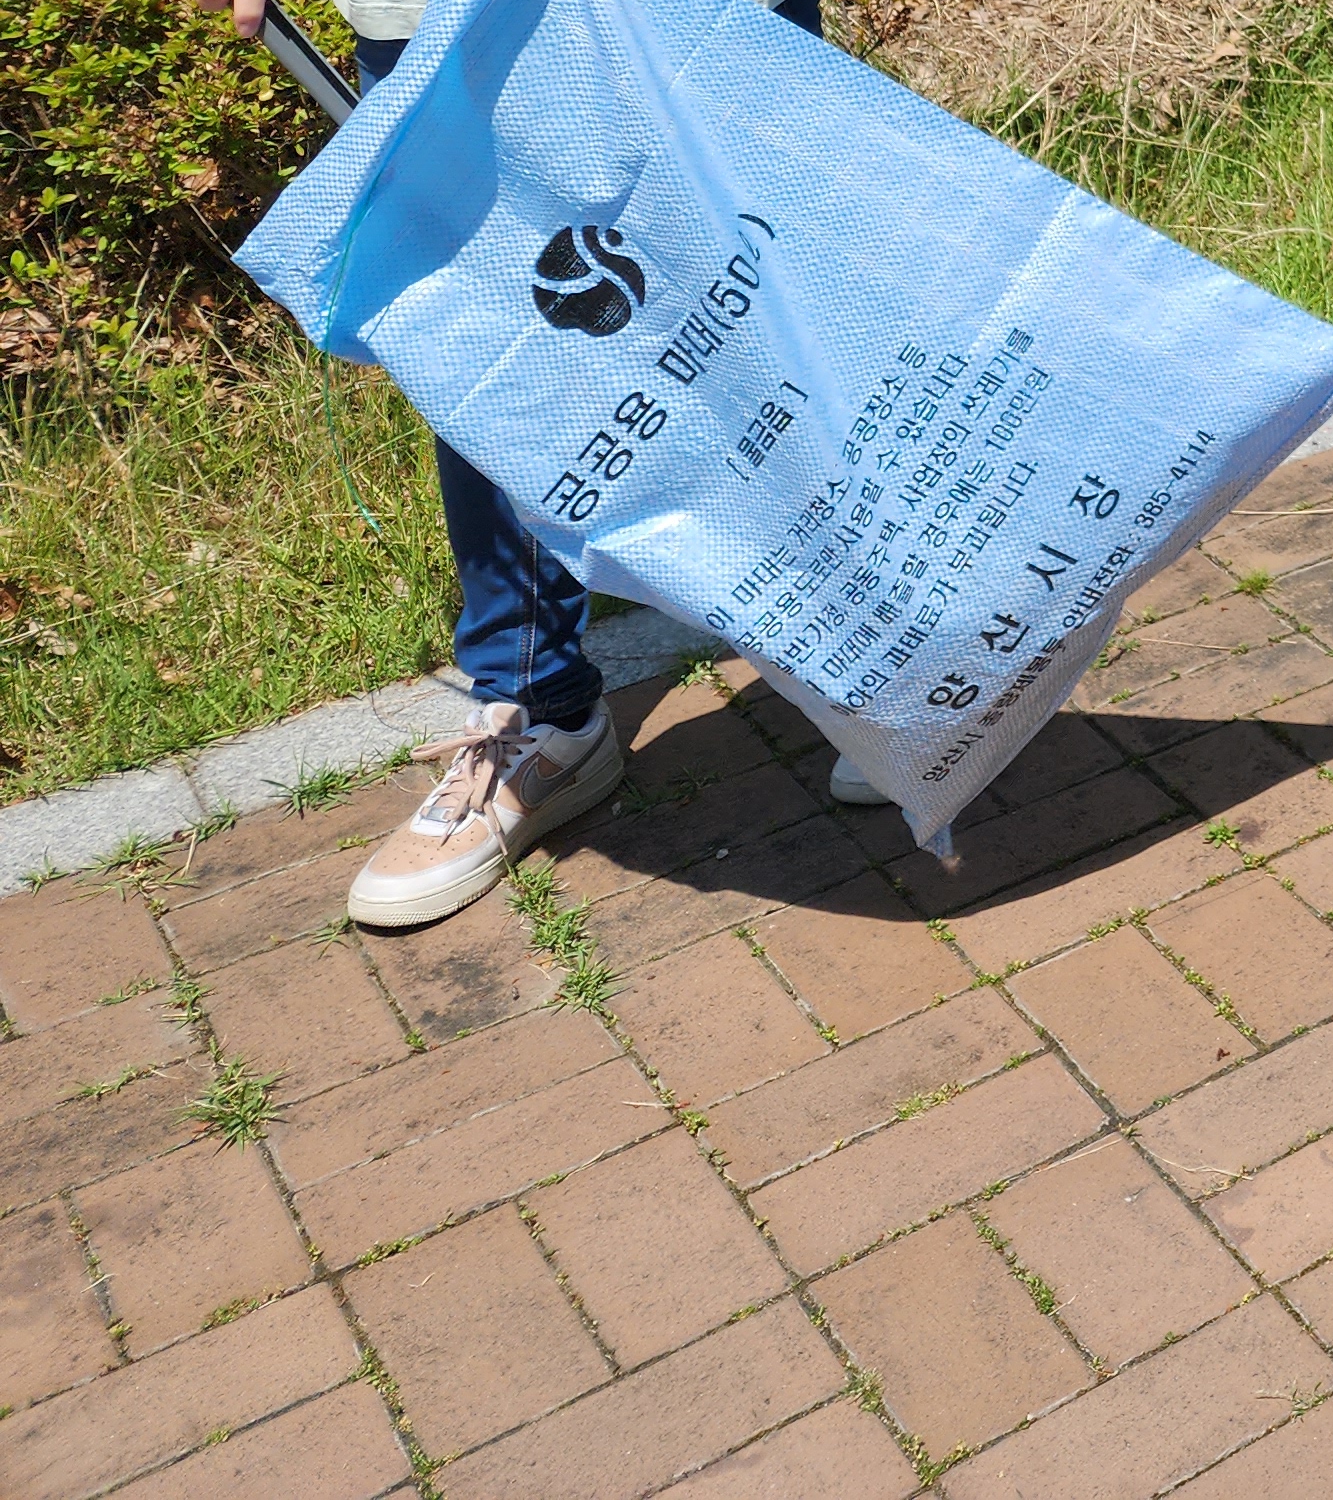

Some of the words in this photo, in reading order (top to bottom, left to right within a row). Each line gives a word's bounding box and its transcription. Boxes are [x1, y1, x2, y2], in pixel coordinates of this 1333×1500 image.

[541, 391, 668, 521] 공공용
[706, 606, 735, 631] 이
[732, 545, 797, 604] 마대는
[841, 374, 908, 465] 공공장소
[898, 343, 927, 369] 등
[839, 477, 886, 553] 사용할
[876, 447, 901, 473] 수
[900, 420, 973, 512] 사업장의
[962, 328, 1035, 421] 쓰레기를
[821, 623, 882, 679] 마대에
[918, 459, 994, 549] 경우에는
[881, 577, 959, 669] 과태료가
[922, 730, 985, 783] 양산시
[1062, 545, 1135, 631] 안내전화
[1134, 429, 1217, 529] 385-4114
